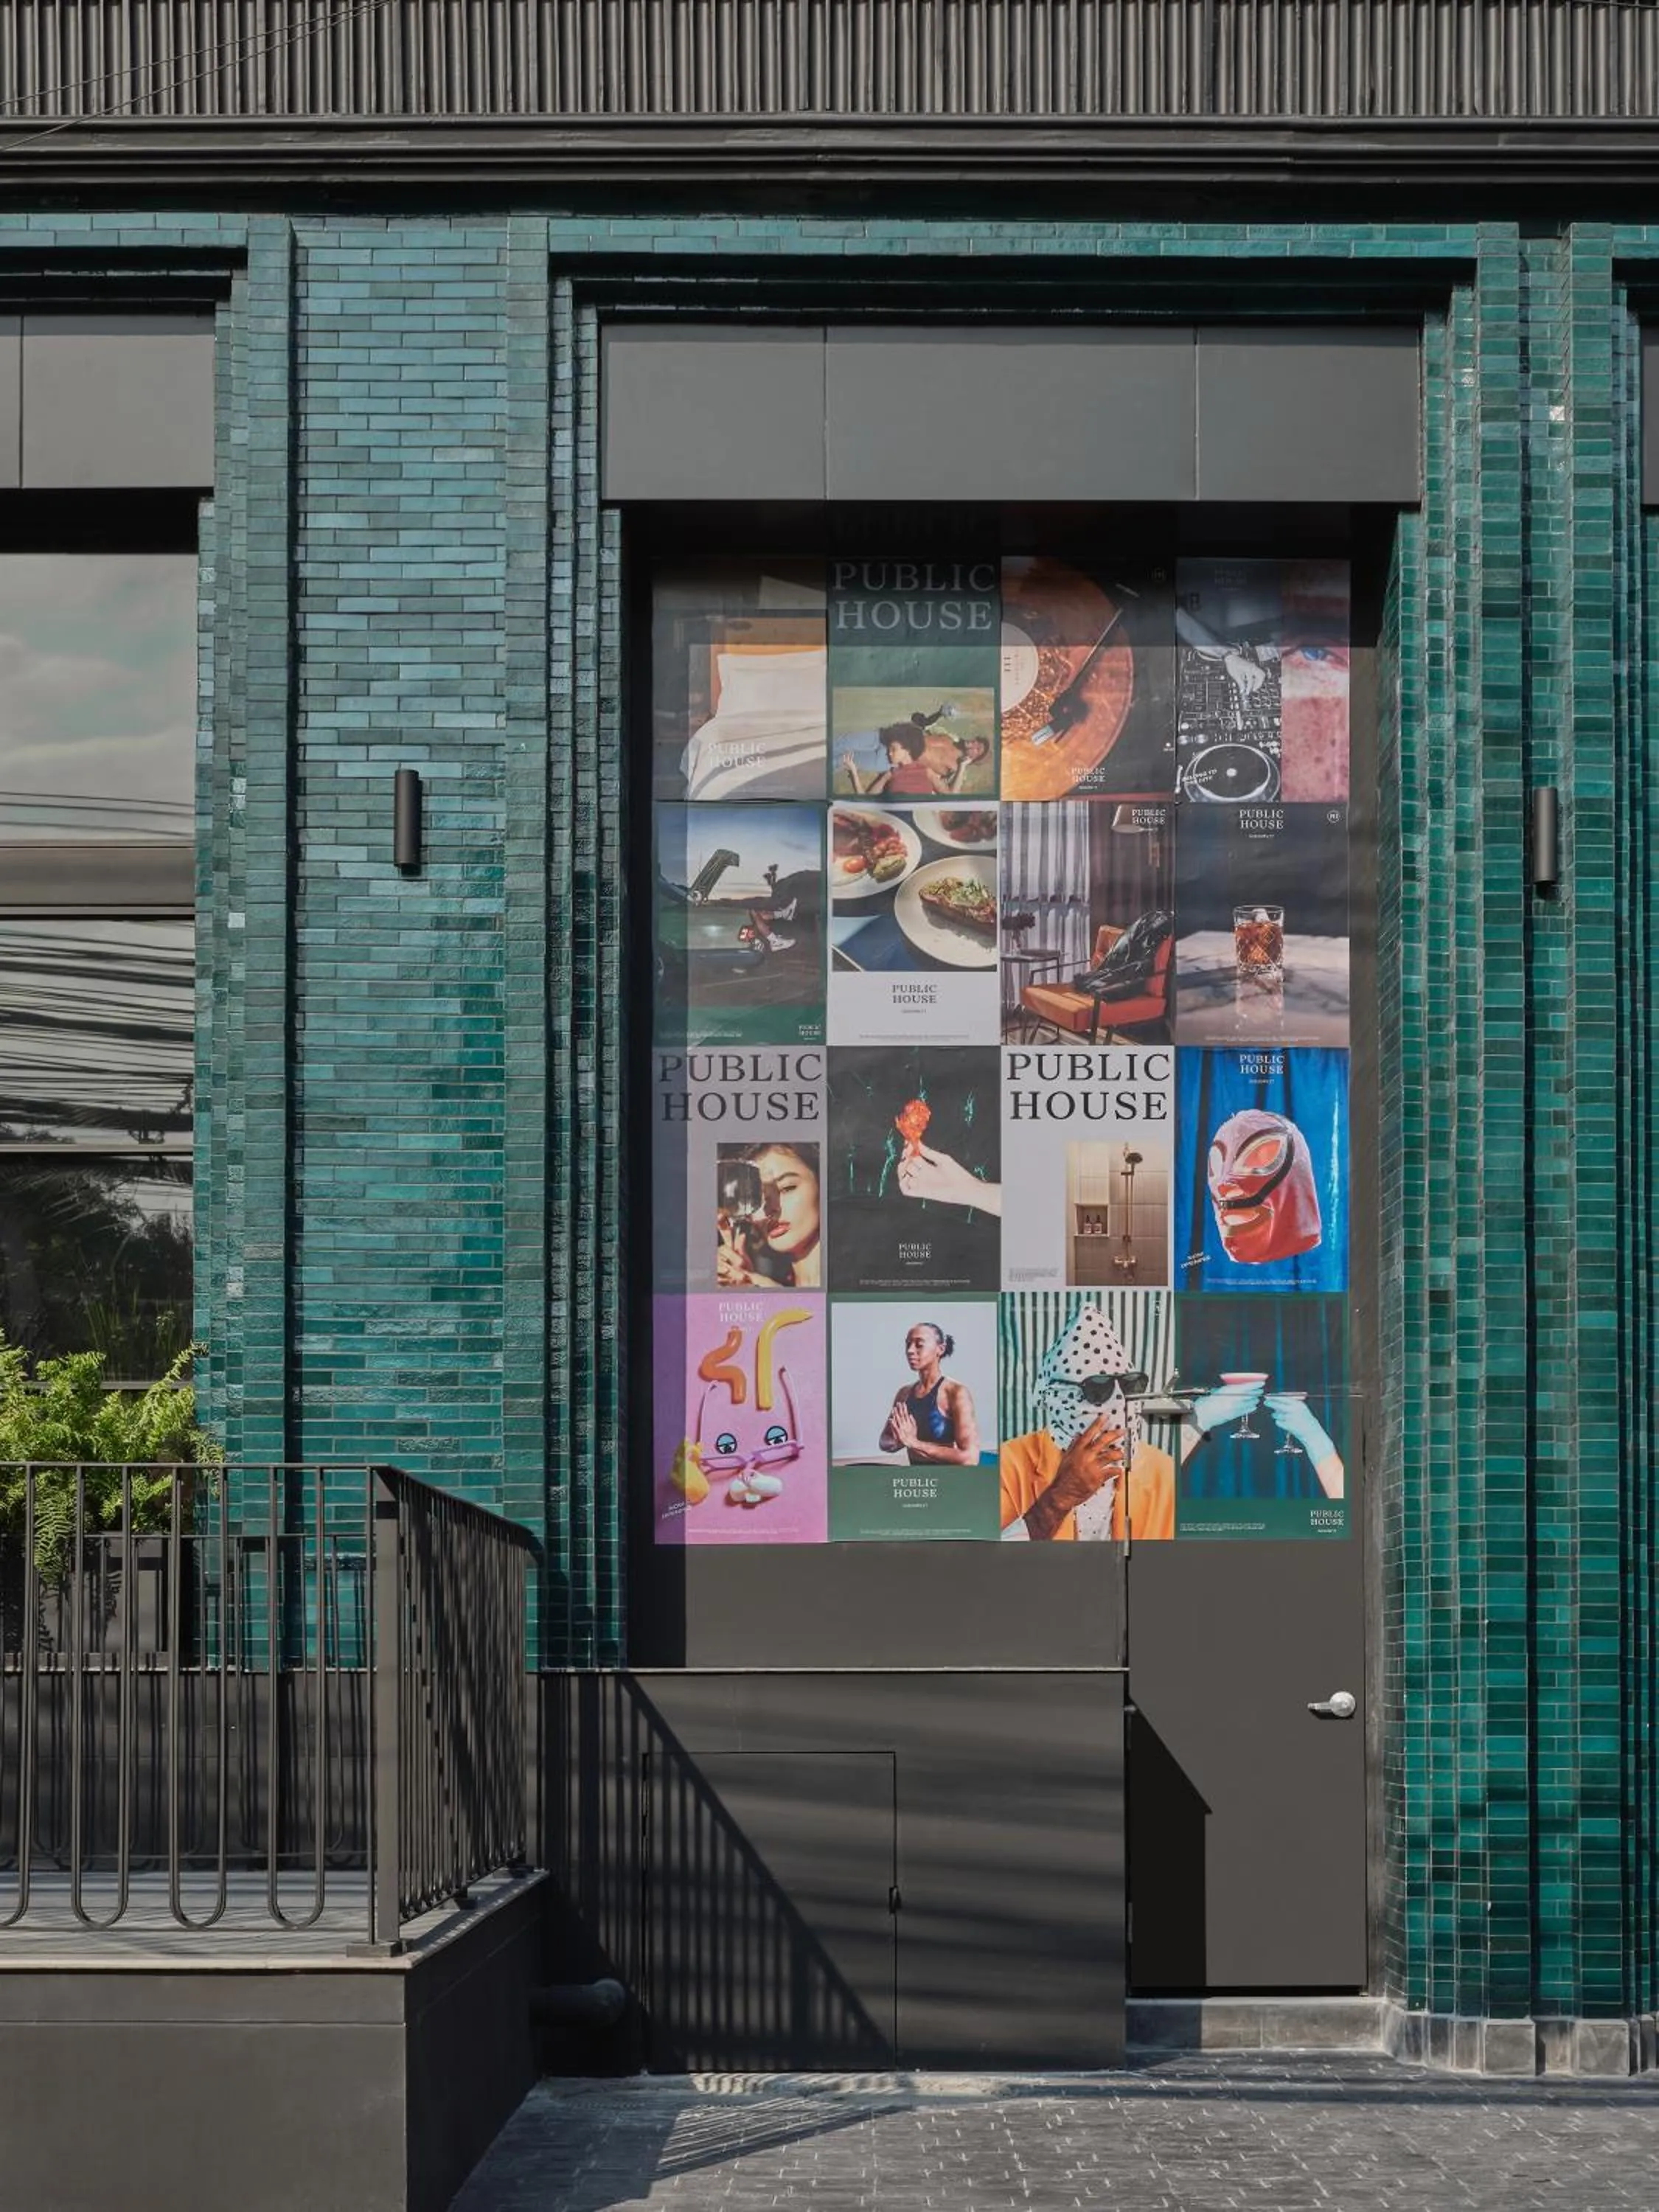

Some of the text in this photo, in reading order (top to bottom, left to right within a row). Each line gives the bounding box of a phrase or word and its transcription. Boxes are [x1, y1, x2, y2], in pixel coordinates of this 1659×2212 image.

[832, 562, 995, 592] PUBLIC
[835, 600, 992, 630] HOUSE
[1132, 809, 1166, 817] PUBLIC
[1239, 810, 1284, 819] PUBLIC
[1133, 817, 1166, 825] HOUSE
[1240, 819, 1284, 830] HOUSE
[892, 984, 938, 993] PUBLIC
[893, 995, 938, 1004] HOUSE
[1239, 1054, 1284, 1064] PUBLIC
[658, 1054, 822, 1082] PUBLIC
[1007, 1054, 1170, 1082] PUBLIC
[1240, 1065, 1284, 1074] HOUSE
[661, 1092, 820, 1121] HOUSE
[1010, 1091, 1168, 1120] HOUSE
[899, 1251, 931, 1259] HOUSE
[719, 1302, 765, 1312] PUBLIC
[720, 1312, 765, 1322] HOUSE
[892, 1478, 939, 1488] PUBLIC
[893, 1489, 938, 1498] HOUSE
[1310, 1510, 1344, 1518] PUBLIC
[1310, 1518, 1345, 1526] HOUSE
